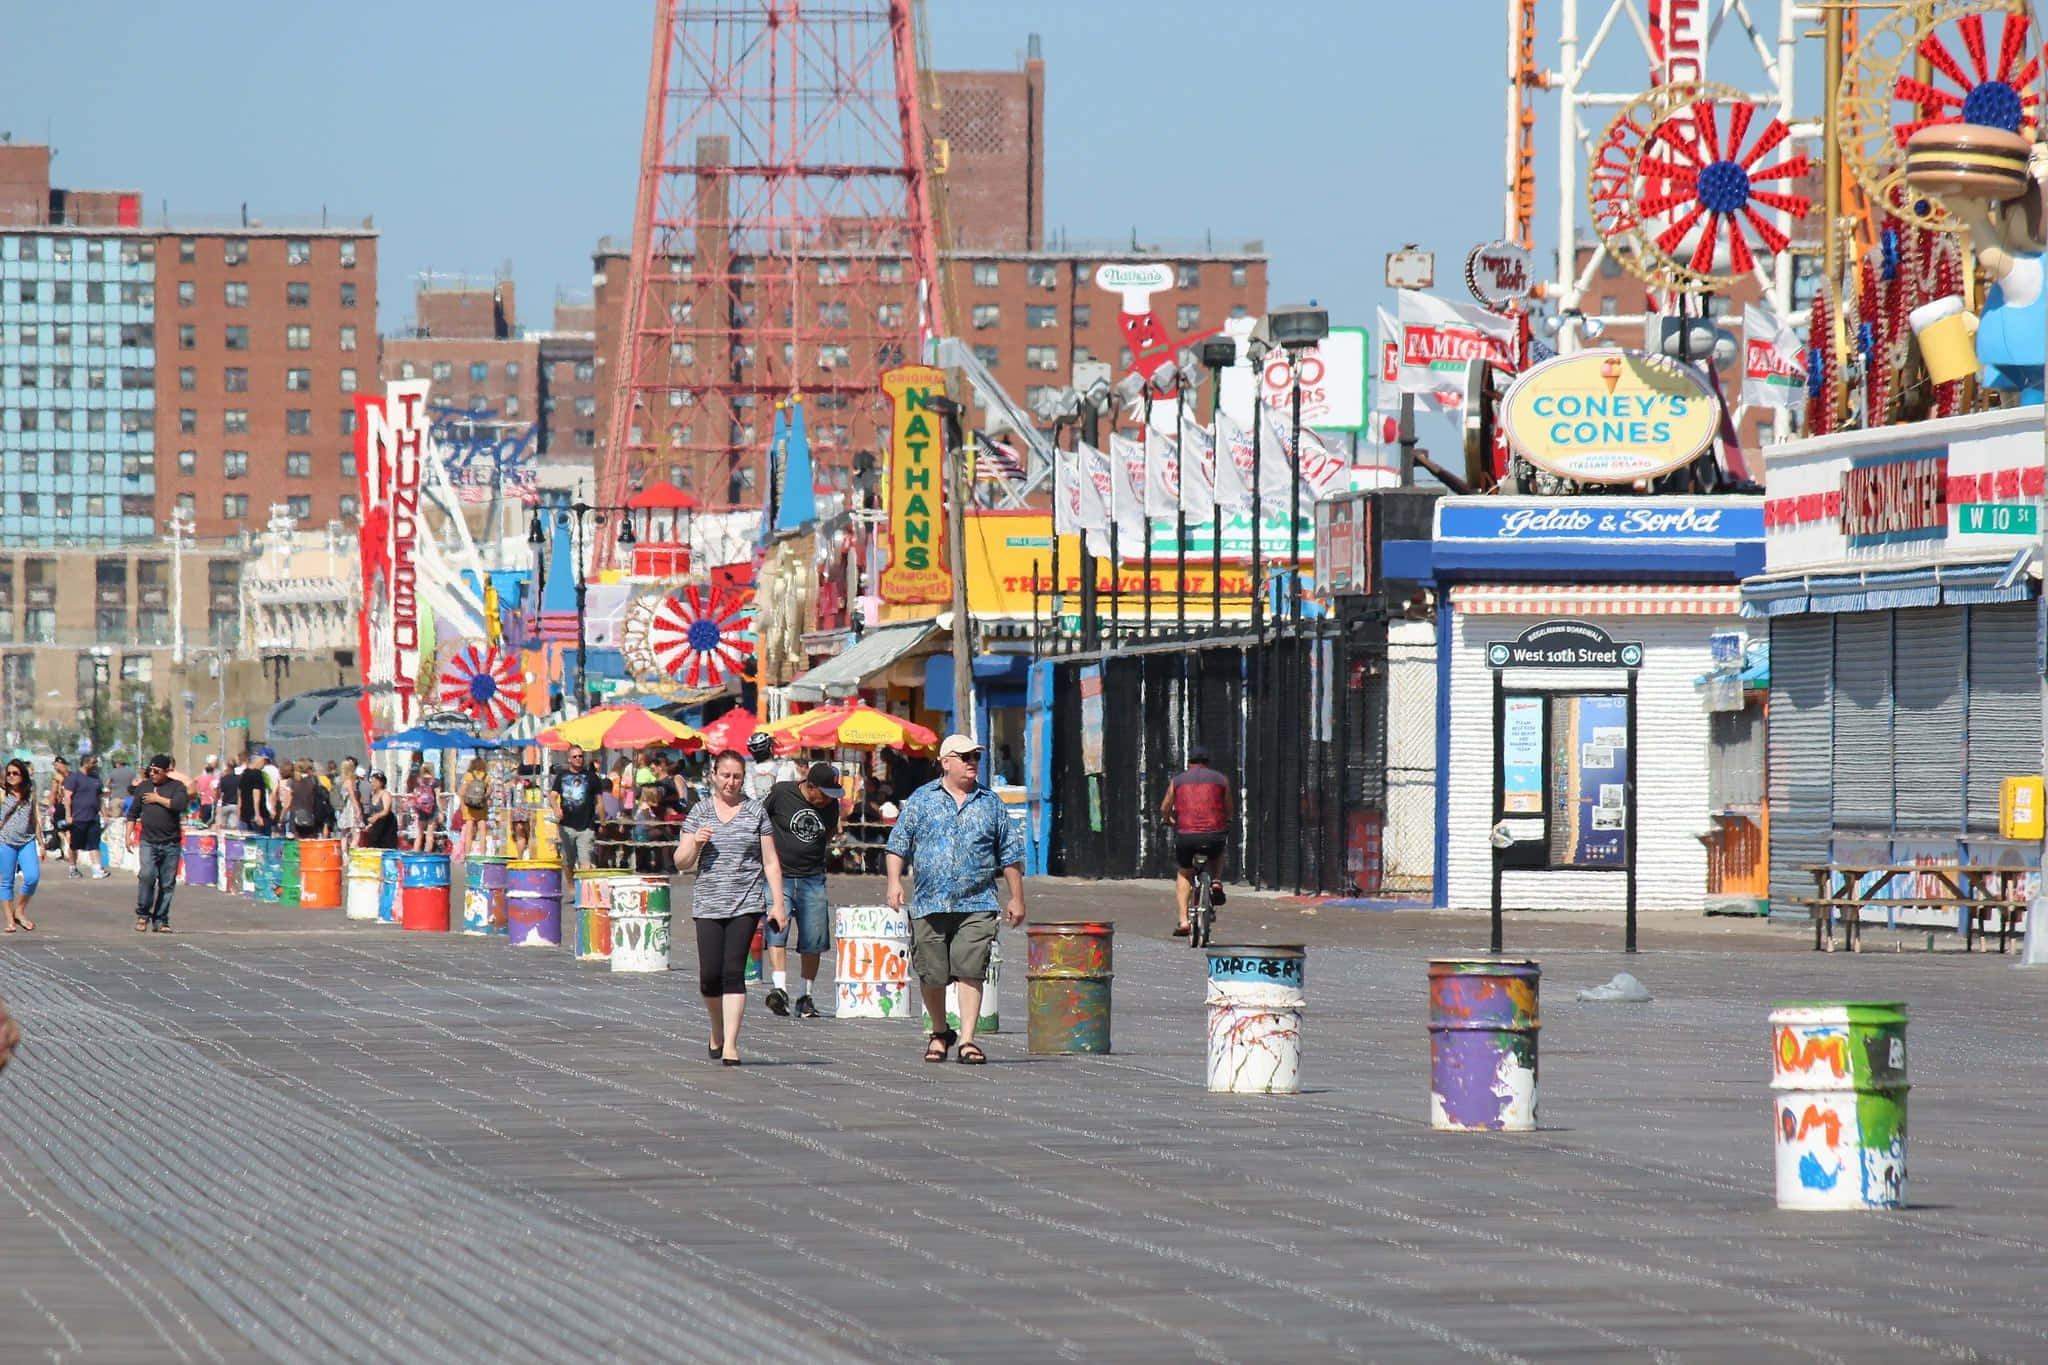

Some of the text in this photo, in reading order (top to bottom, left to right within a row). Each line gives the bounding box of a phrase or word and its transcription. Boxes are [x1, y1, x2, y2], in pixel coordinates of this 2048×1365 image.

[1532, 395, 1688, 417] CONEY'S
[1550, 421, 1671, 444] CONES
[904, 387, 930, 570] NATHANS
[1498, 506, 1723, 537] Gelato & Sorbet
[1970, 506, 2030, 530] W 10 St
[392, 393, 422, 724] THUNDERBOLT
[1003, 576, 1050, 592] THE
[1066, 576, 1162, 592] FAVOR
[1513, 648, 1617, 663] West 10th Street
